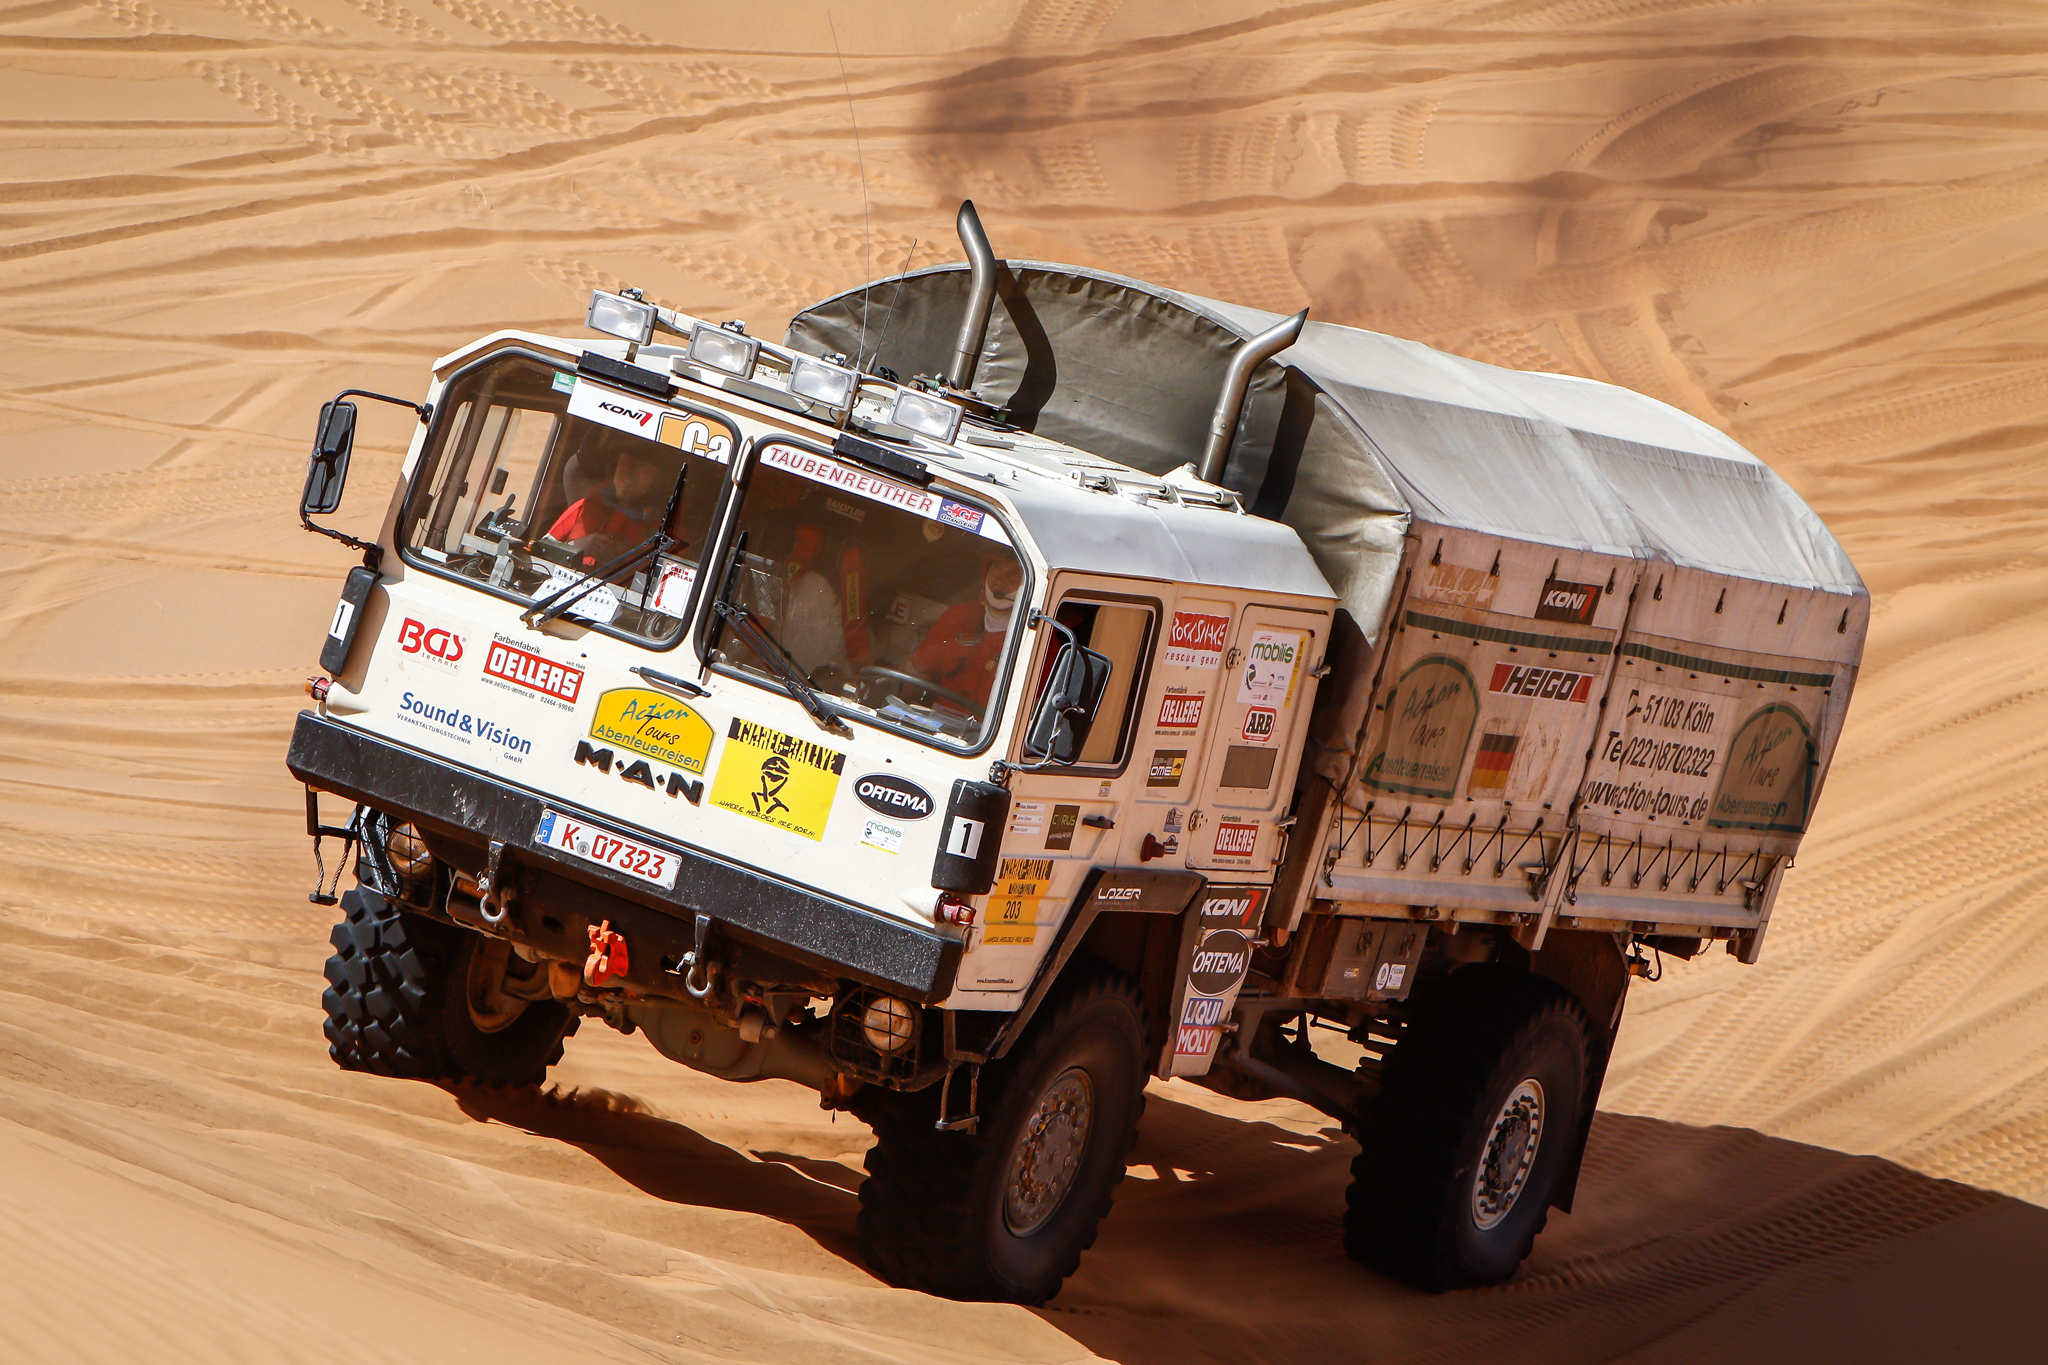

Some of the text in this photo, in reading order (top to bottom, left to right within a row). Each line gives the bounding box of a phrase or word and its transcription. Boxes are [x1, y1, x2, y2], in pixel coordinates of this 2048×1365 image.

[769, 447, 934, 513] TAUBENREUTHER
[1543, 589, 1586, 610] KONI
[333, 604, 346, 634] 1
[397, 617, 464, 662] BGS
[493, 632, 541, 655] Farbenfabrik
[421, 652, 460, 670] technic
[1165, 652, 1219, 666] rescue gear
[1251, 643, 1294, 663] mobilis
[488, 646, 580, 698] OELLERS
[1503, 666, 1580, 701] HEIGO
[619, 698, 689, 722] Action
[1160, 699, 1202, 723] OELLERS
[1682, 701, 1715, 733] Köln
[636, 714, 680, 745] Tours
[1246, 712, 1274, 735] ARB
[595, 724, 700, 769] Abenteuerreisen
[858, 781, 928, 814] ORTEMA
[865, 820, 902, 838] mobilis
[963, 822, 973, 855] 1
[1216, 828, 1256, 852] OELLERS
[542, 823, 666, 879] D K 07323
[1003, 900, 1022, 920] 203
[1201, 898, 1250, 916] KONI
[1192, 951, 1245, 974] ORTEMA
[1184, 999, 1222, 1026] LIQUI
[1176, 1028, 1215, 1053] MOLY
